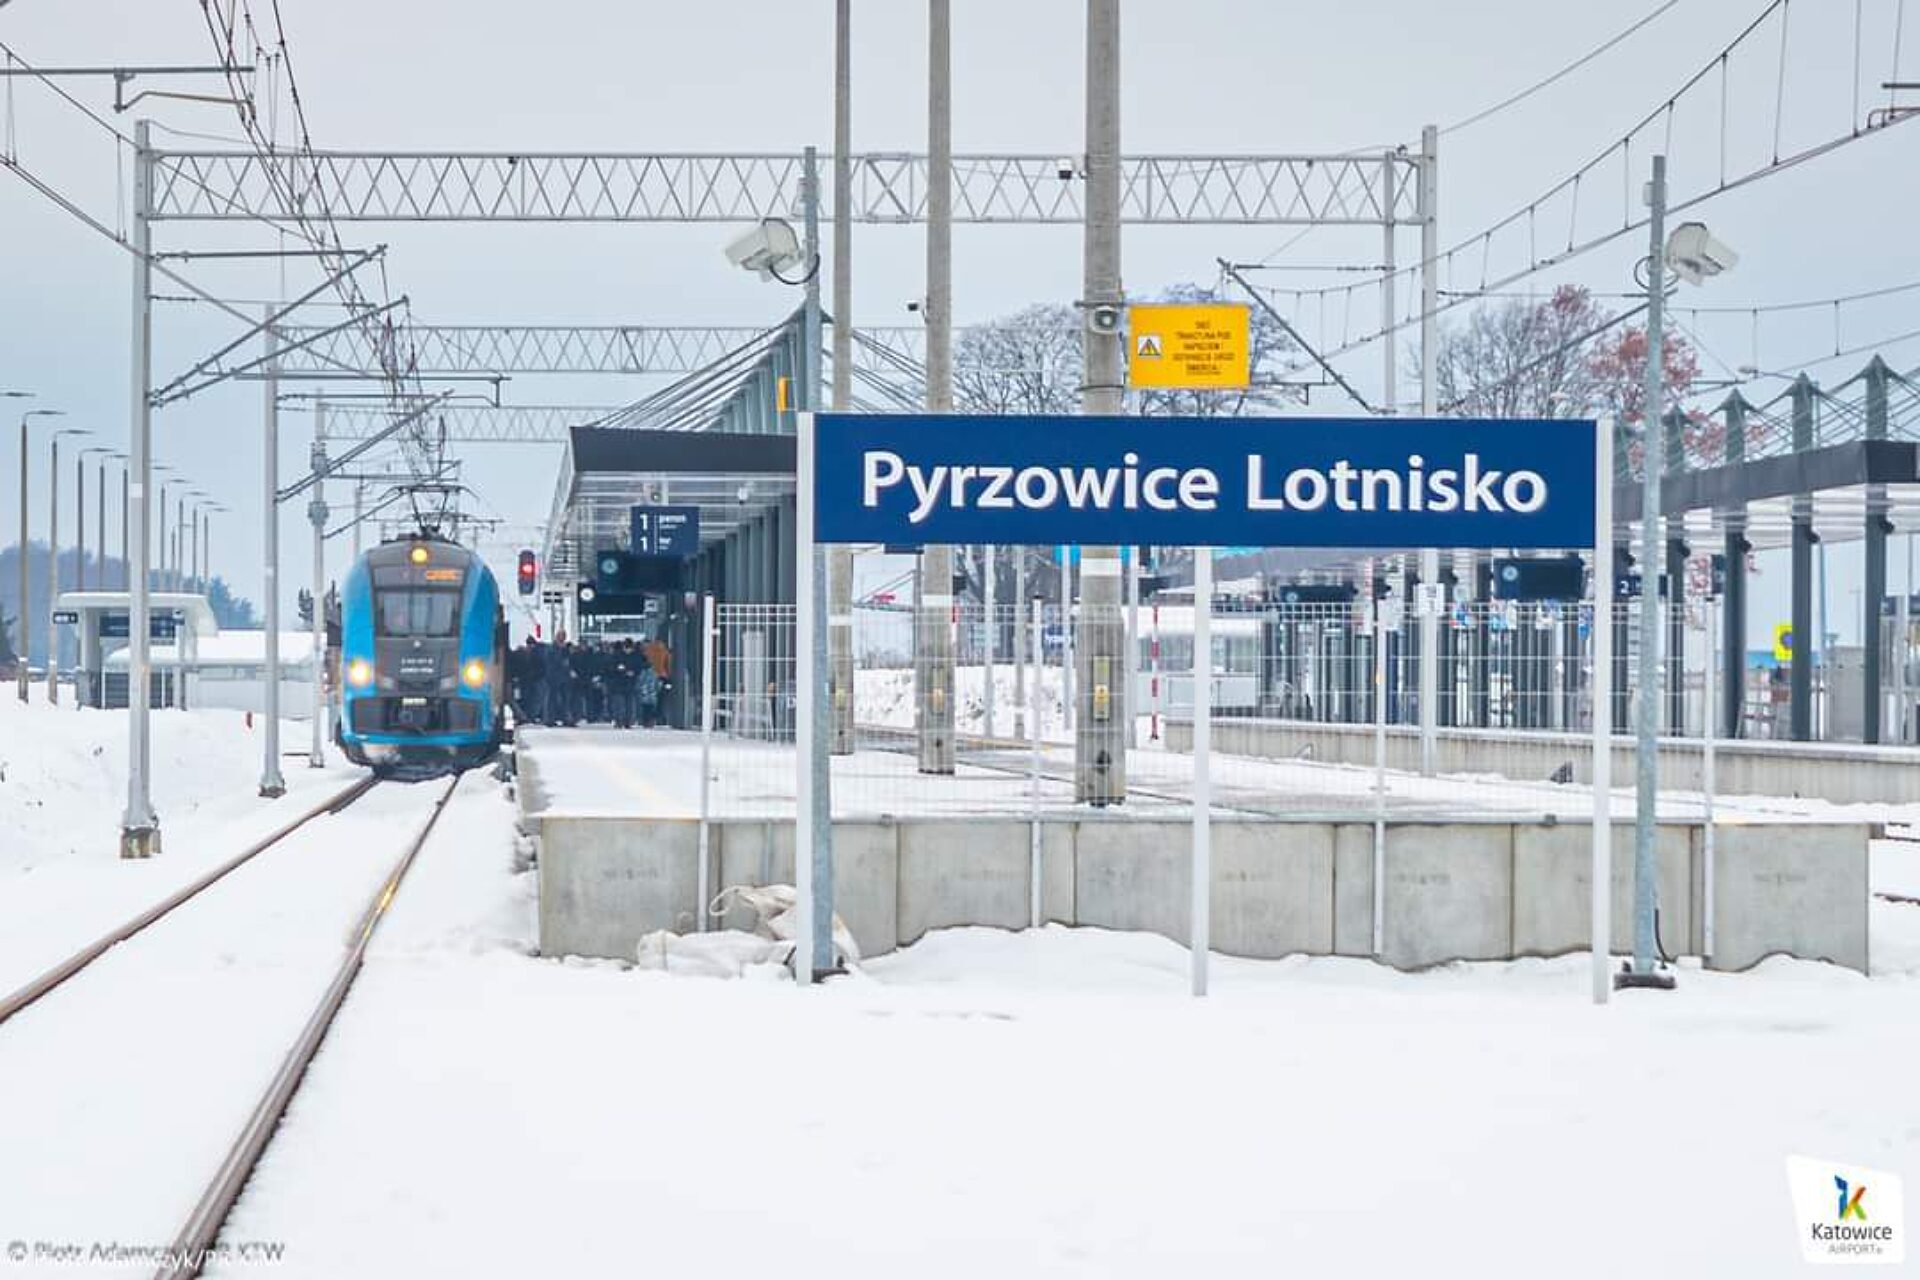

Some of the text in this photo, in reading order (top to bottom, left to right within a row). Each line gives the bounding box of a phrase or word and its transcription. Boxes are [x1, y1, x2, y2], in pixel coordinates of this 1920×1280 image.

[864, 451, 1547, 522] Pyrzowice Lotnisko
[639, 513, 648, 530] 1
[639, 536, 648, 552] 1
[1620, 580, 1630, 594] 2
